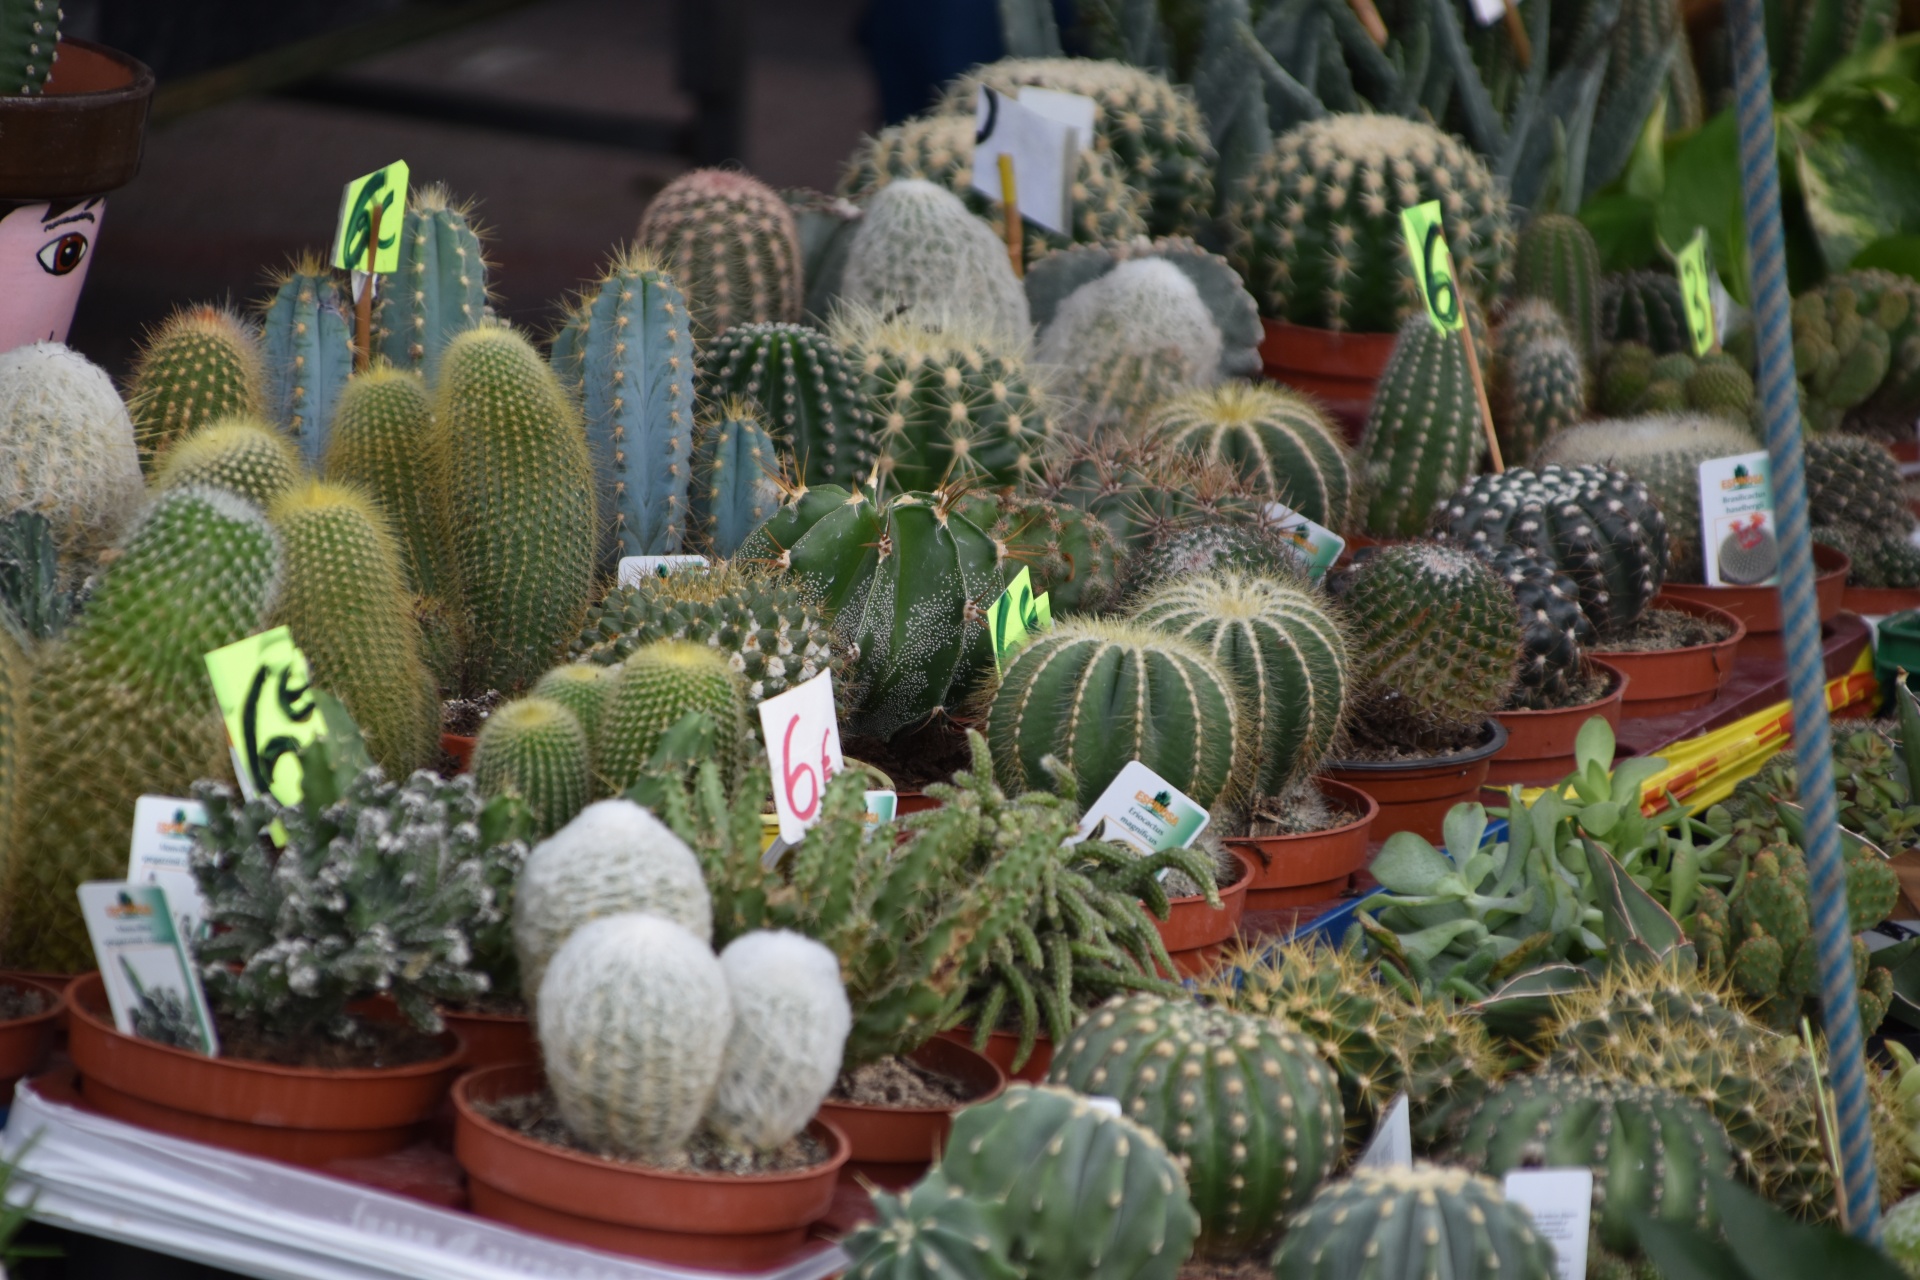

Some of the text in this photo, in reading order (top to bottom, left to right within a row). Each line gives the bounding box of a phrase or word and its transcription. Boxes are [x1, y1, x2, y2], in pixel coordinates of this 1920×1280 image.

[1128, 806, 1165, 837] Eriocactus
[1134, 789, 1179, 827] ESPINOSA
[1119, 815, 1158, 847] magnificus
